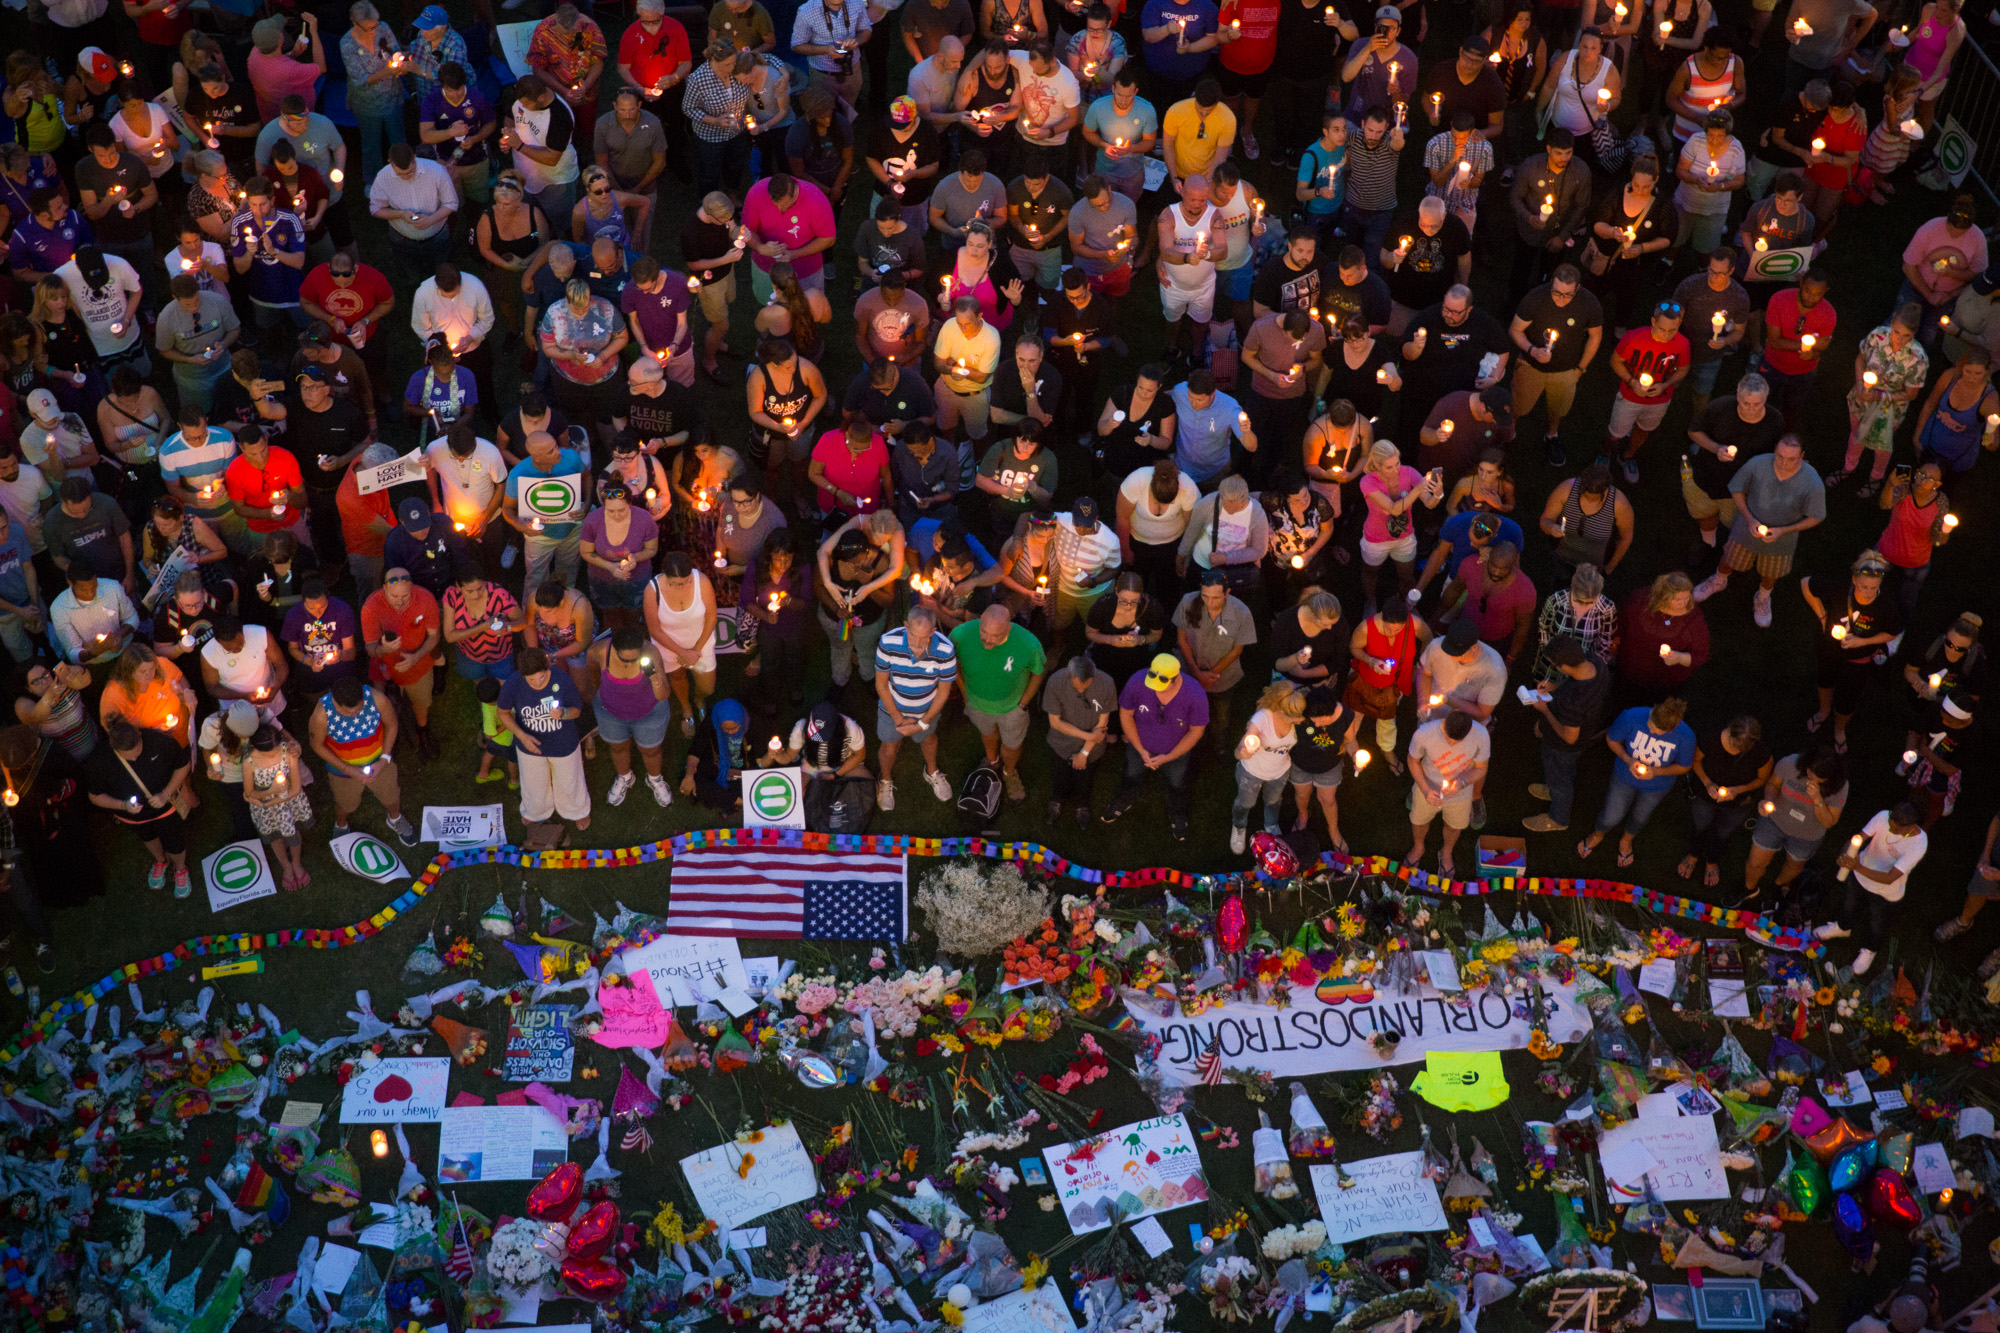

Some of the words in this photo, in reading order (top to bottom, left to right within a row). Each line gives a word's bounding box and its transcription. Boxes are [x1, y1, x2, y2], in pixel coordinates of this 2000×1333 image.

[516, 116, 540, 136] ORLANDO
[85, 307, 109, 316] ORLANDO
[110, 301, 122, 312] CITY
[630, 405, 673, 418] PLEASE
[631, 419, 673, 432] EVOLVE
[376, 462, 404, 476] LOVE
[378, 472, 406, 484] HATE
[74, 529, 106, 547] HATE
[1630, 730, 1676, 762] JUST
[442, 826, 470, 834] LOVE
[216, 888, 272, 909] EqualityFlorida.org
[511, 1010, 570, 1028] LIGHT
[530, 1050, 551, 1058] ONLY
[505, 1056, 563, 1068] DARKNESS
[510, 1066, 534, 1075] THEIR
[354, 1108, 377, 1117] our
[382, 1108, 395, 1117] in
[401, 1098, 440, 1119] Always
[1136, 1114, 1182, 1132] Sorry
[1162, 1144, 1192, 1156] We
[1066, 1170, 1102, 1187] orlando
[1082, 1178, 1102, 1192] pray
[1064, 1187, 1080, 1198] for
[1384, 1178, 1422, 1196] YOUR
[1344, 1197, 1373, 1212] YOU
[1414, 1192, 1428, 1204] IS
[724, 1192, 782, 1226] Concord
[1335, 1216, 1362, 1234] NC
